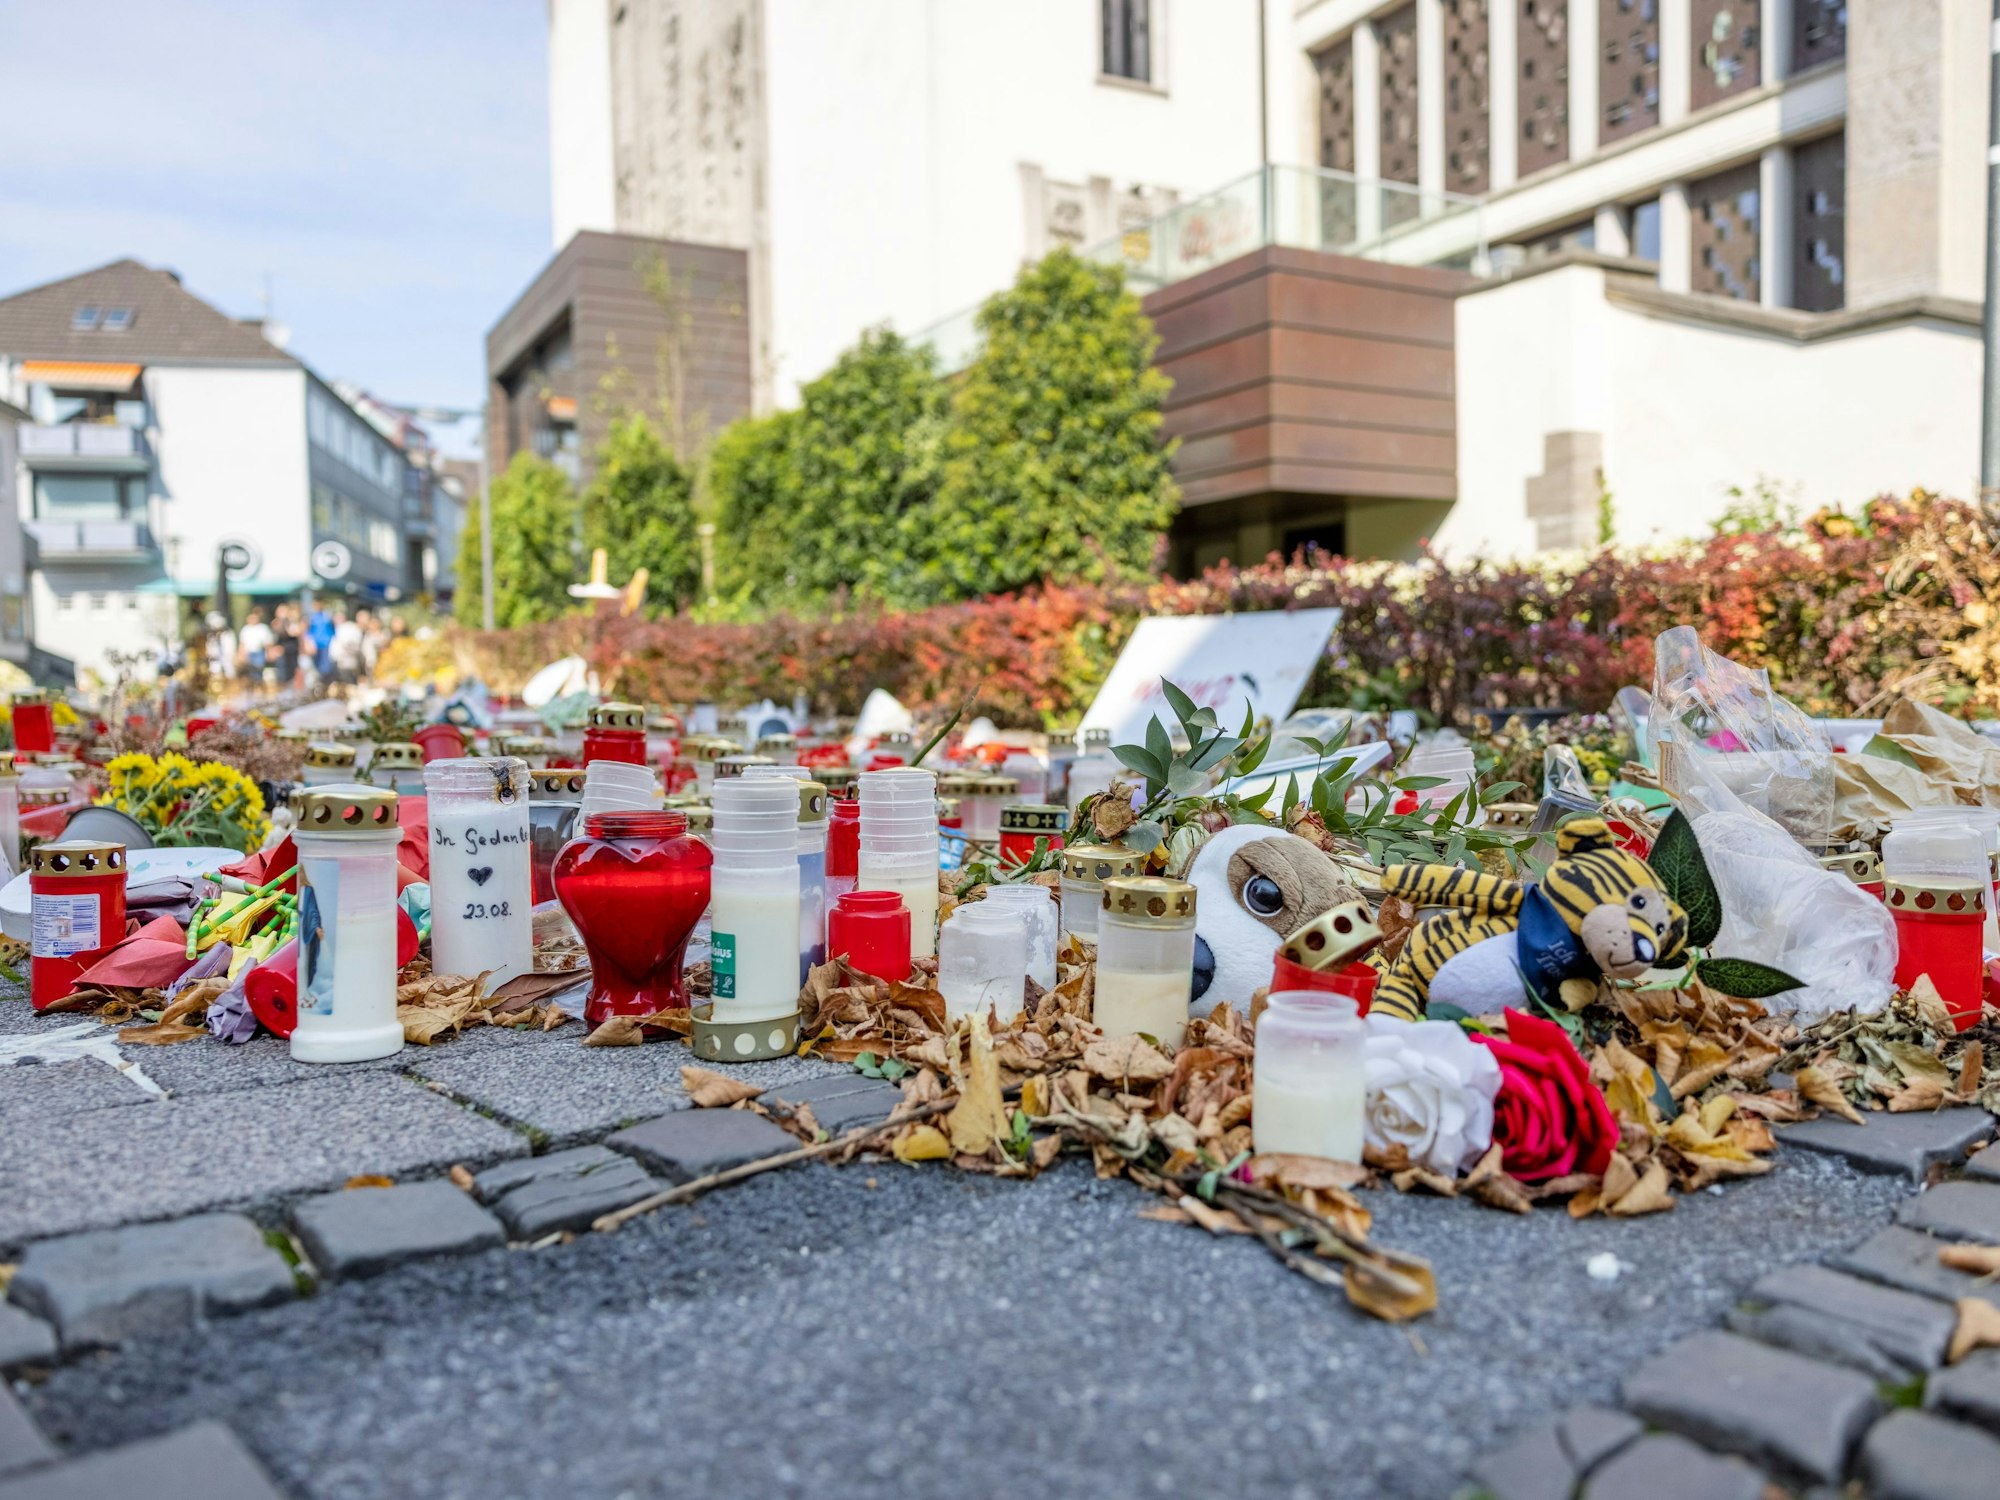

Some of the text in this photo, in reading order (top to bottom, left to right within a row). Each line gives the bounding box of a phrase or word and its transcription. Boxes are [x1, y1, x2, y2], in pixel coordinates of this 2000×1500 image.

[435, 827, 456, 846] In
[462, 901, 512, 920] 23.08.
[1547, 940, 1577, 964] Ich
